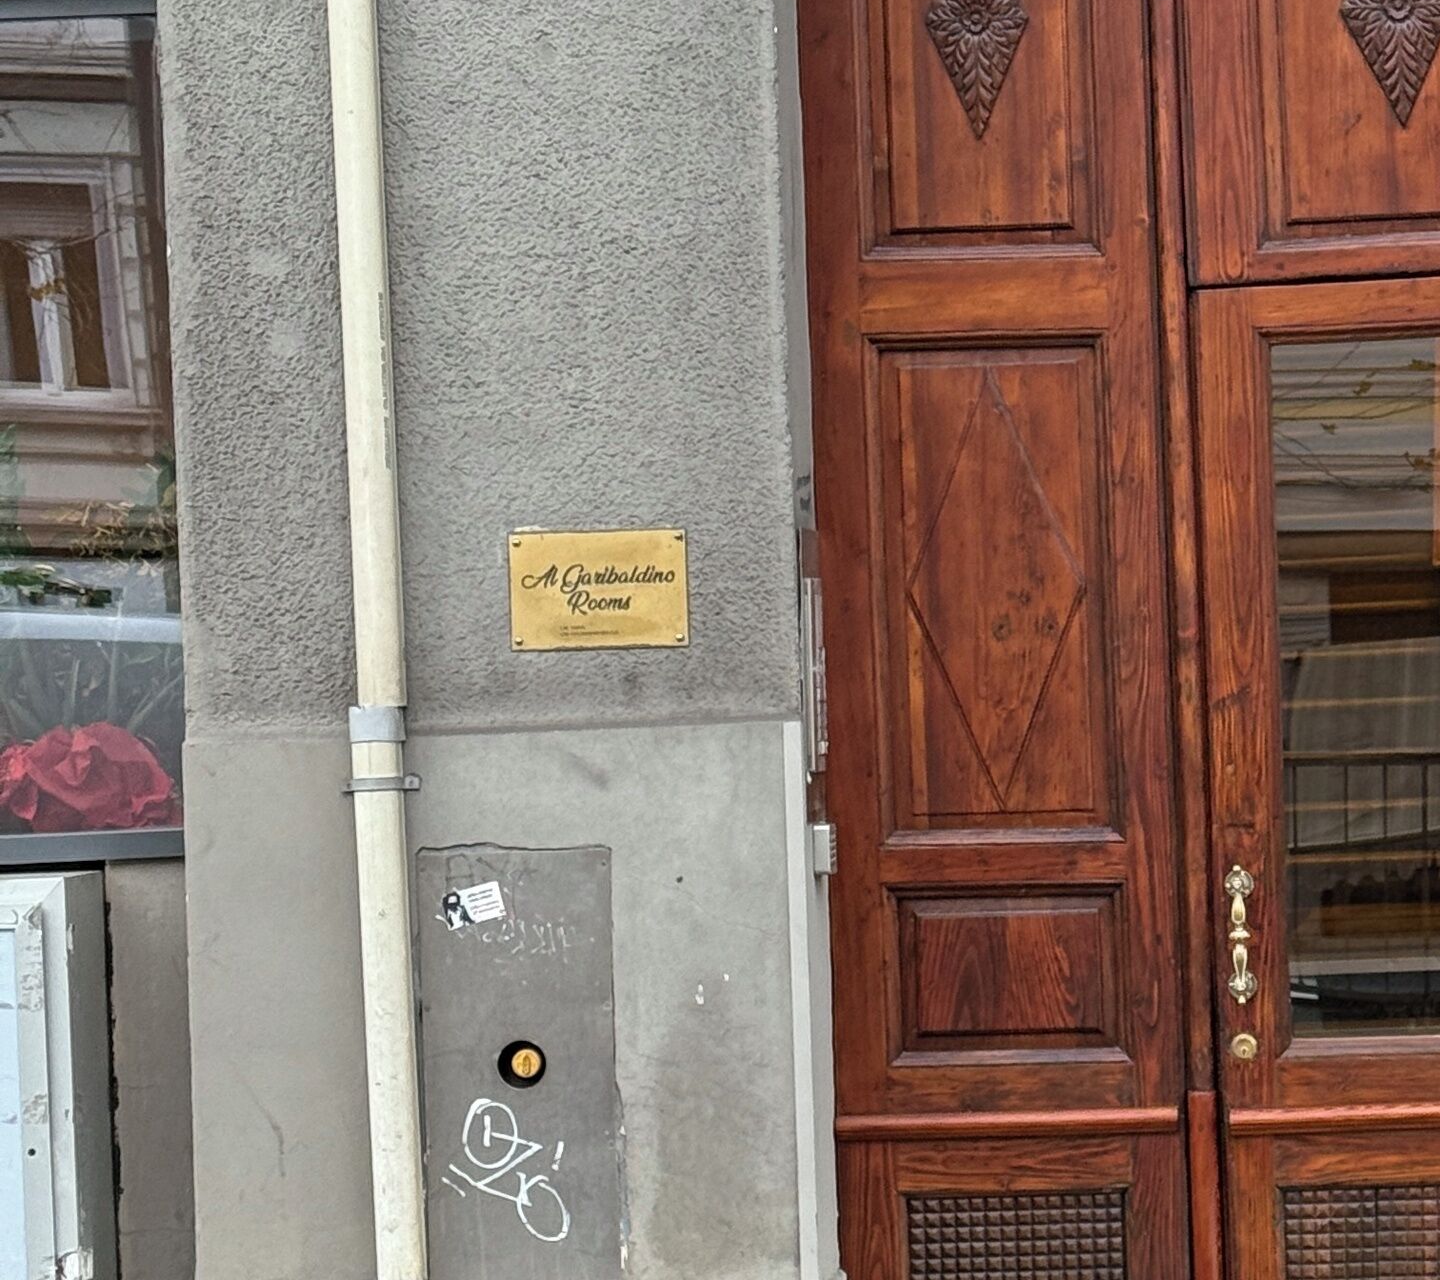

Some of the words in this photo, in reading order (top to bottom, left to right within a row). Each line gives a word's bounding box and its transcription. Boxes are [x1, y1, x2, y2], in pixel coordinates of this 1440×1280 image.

[521, 564, 558, 590] Al
[560, 563, 675, 594] Garibaldino
[567, 590, 632, 616] Rooms
